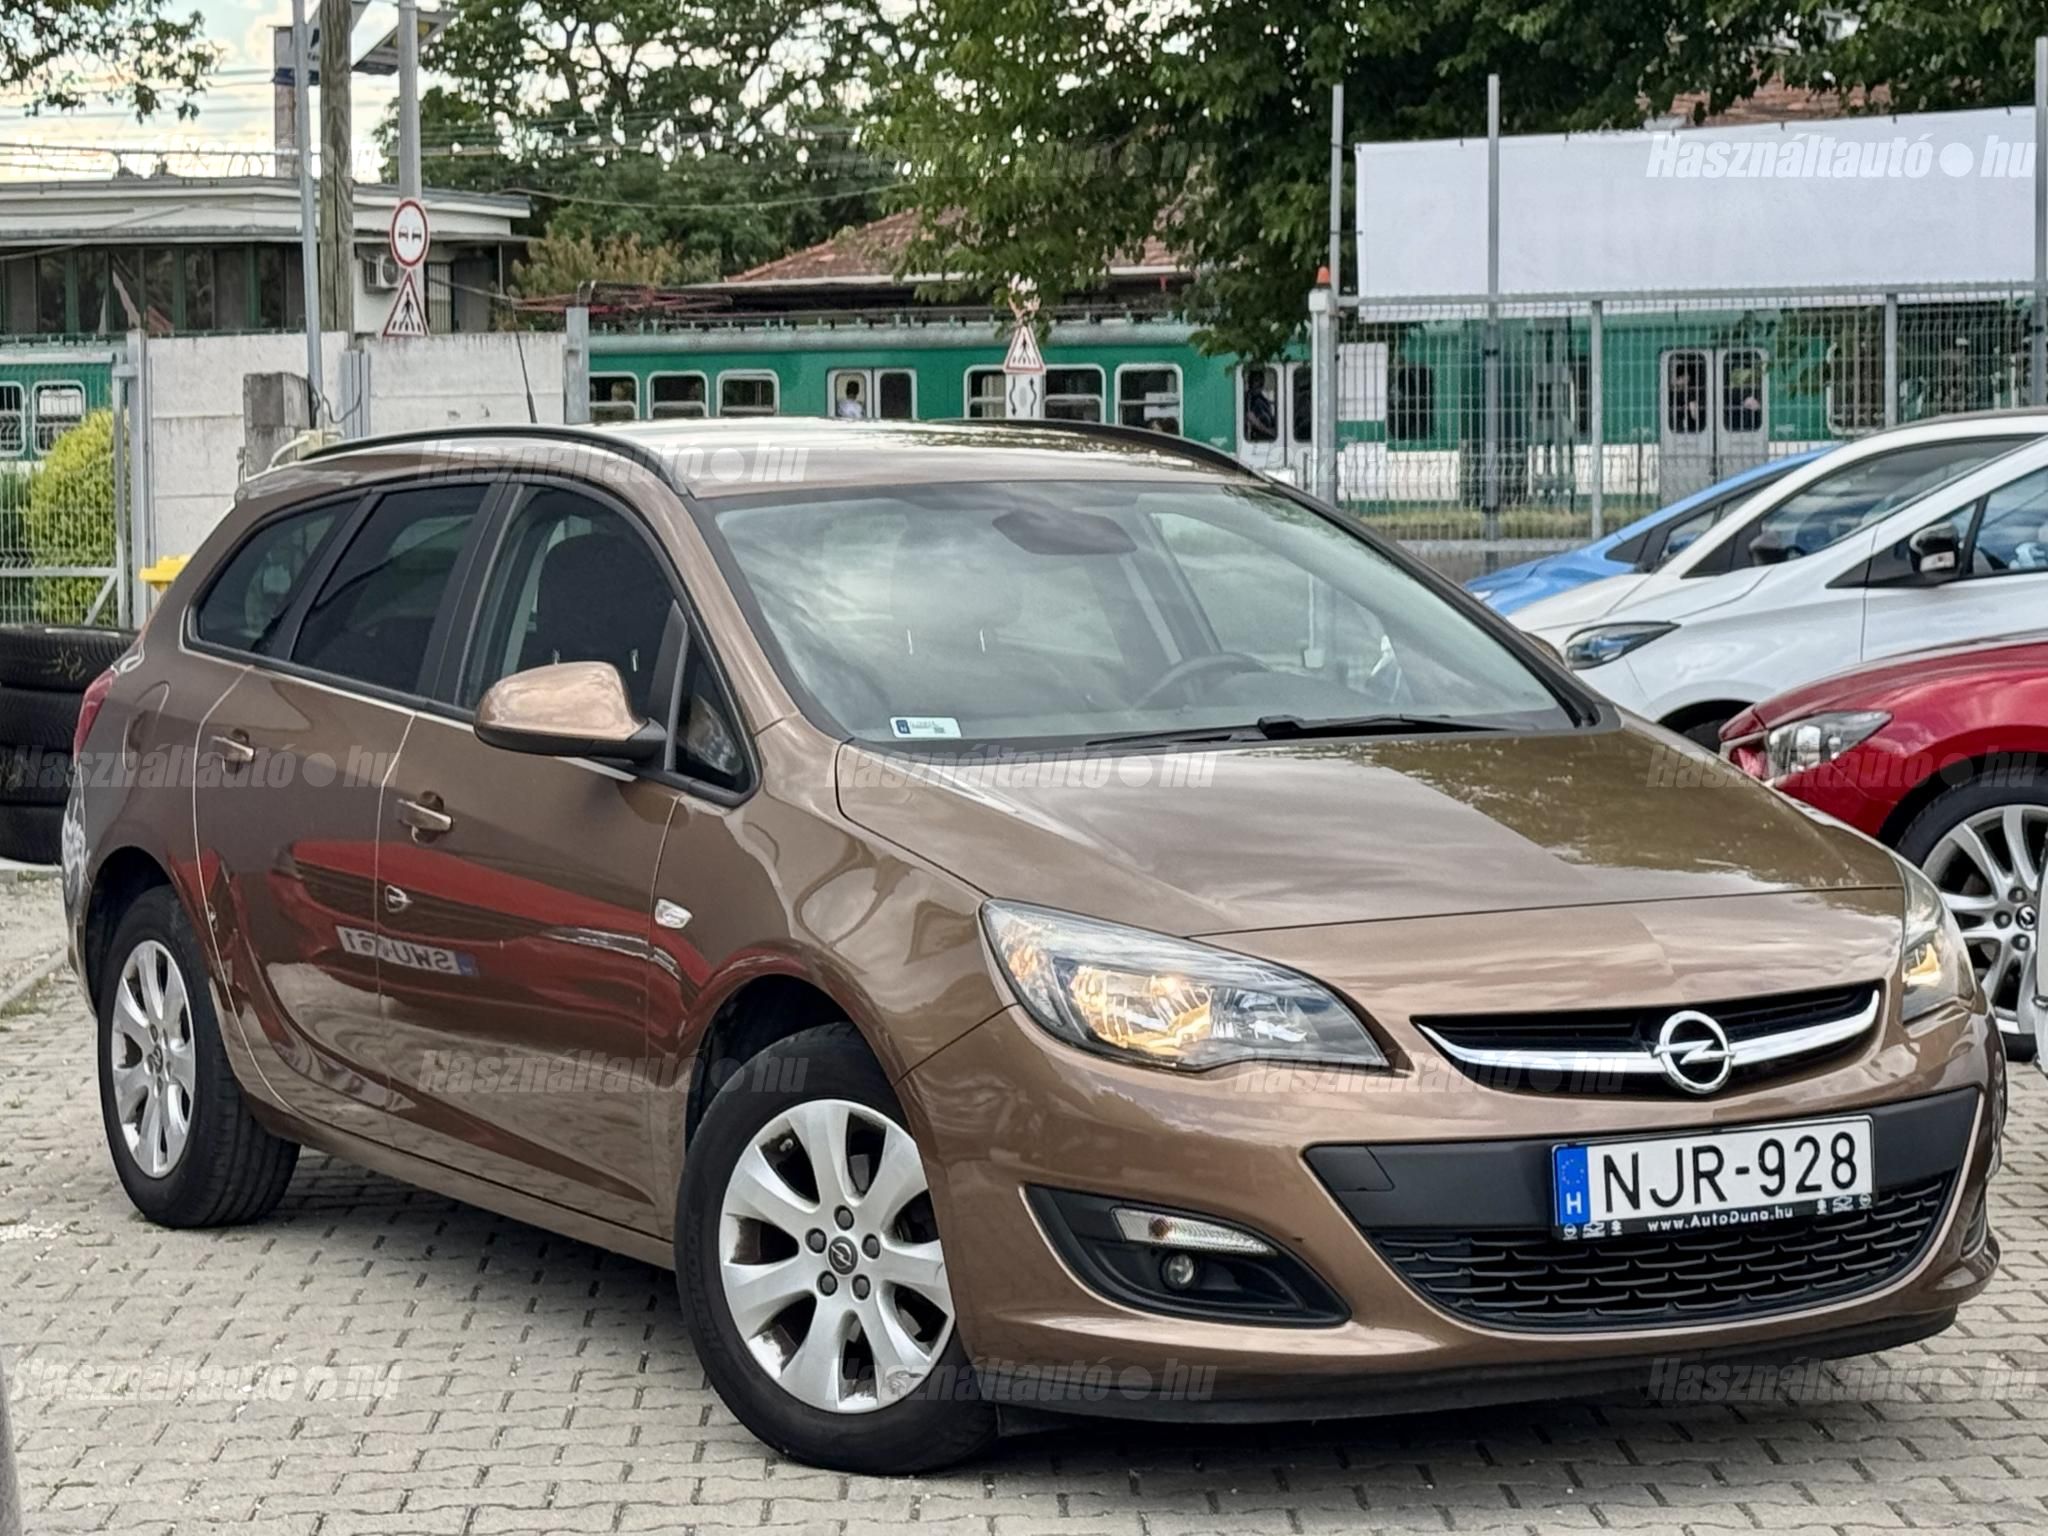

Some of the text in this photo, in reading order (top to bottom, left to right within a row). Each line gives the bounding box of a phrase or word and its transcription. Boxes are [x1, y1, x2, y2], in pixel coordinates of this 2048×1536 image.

[1603, 1131, 1858, 1213] NJR-928
[1565, 1191, 1583, 1215] H
[1647, 1207, 1794, 1233] www.AutoDuna.hu
